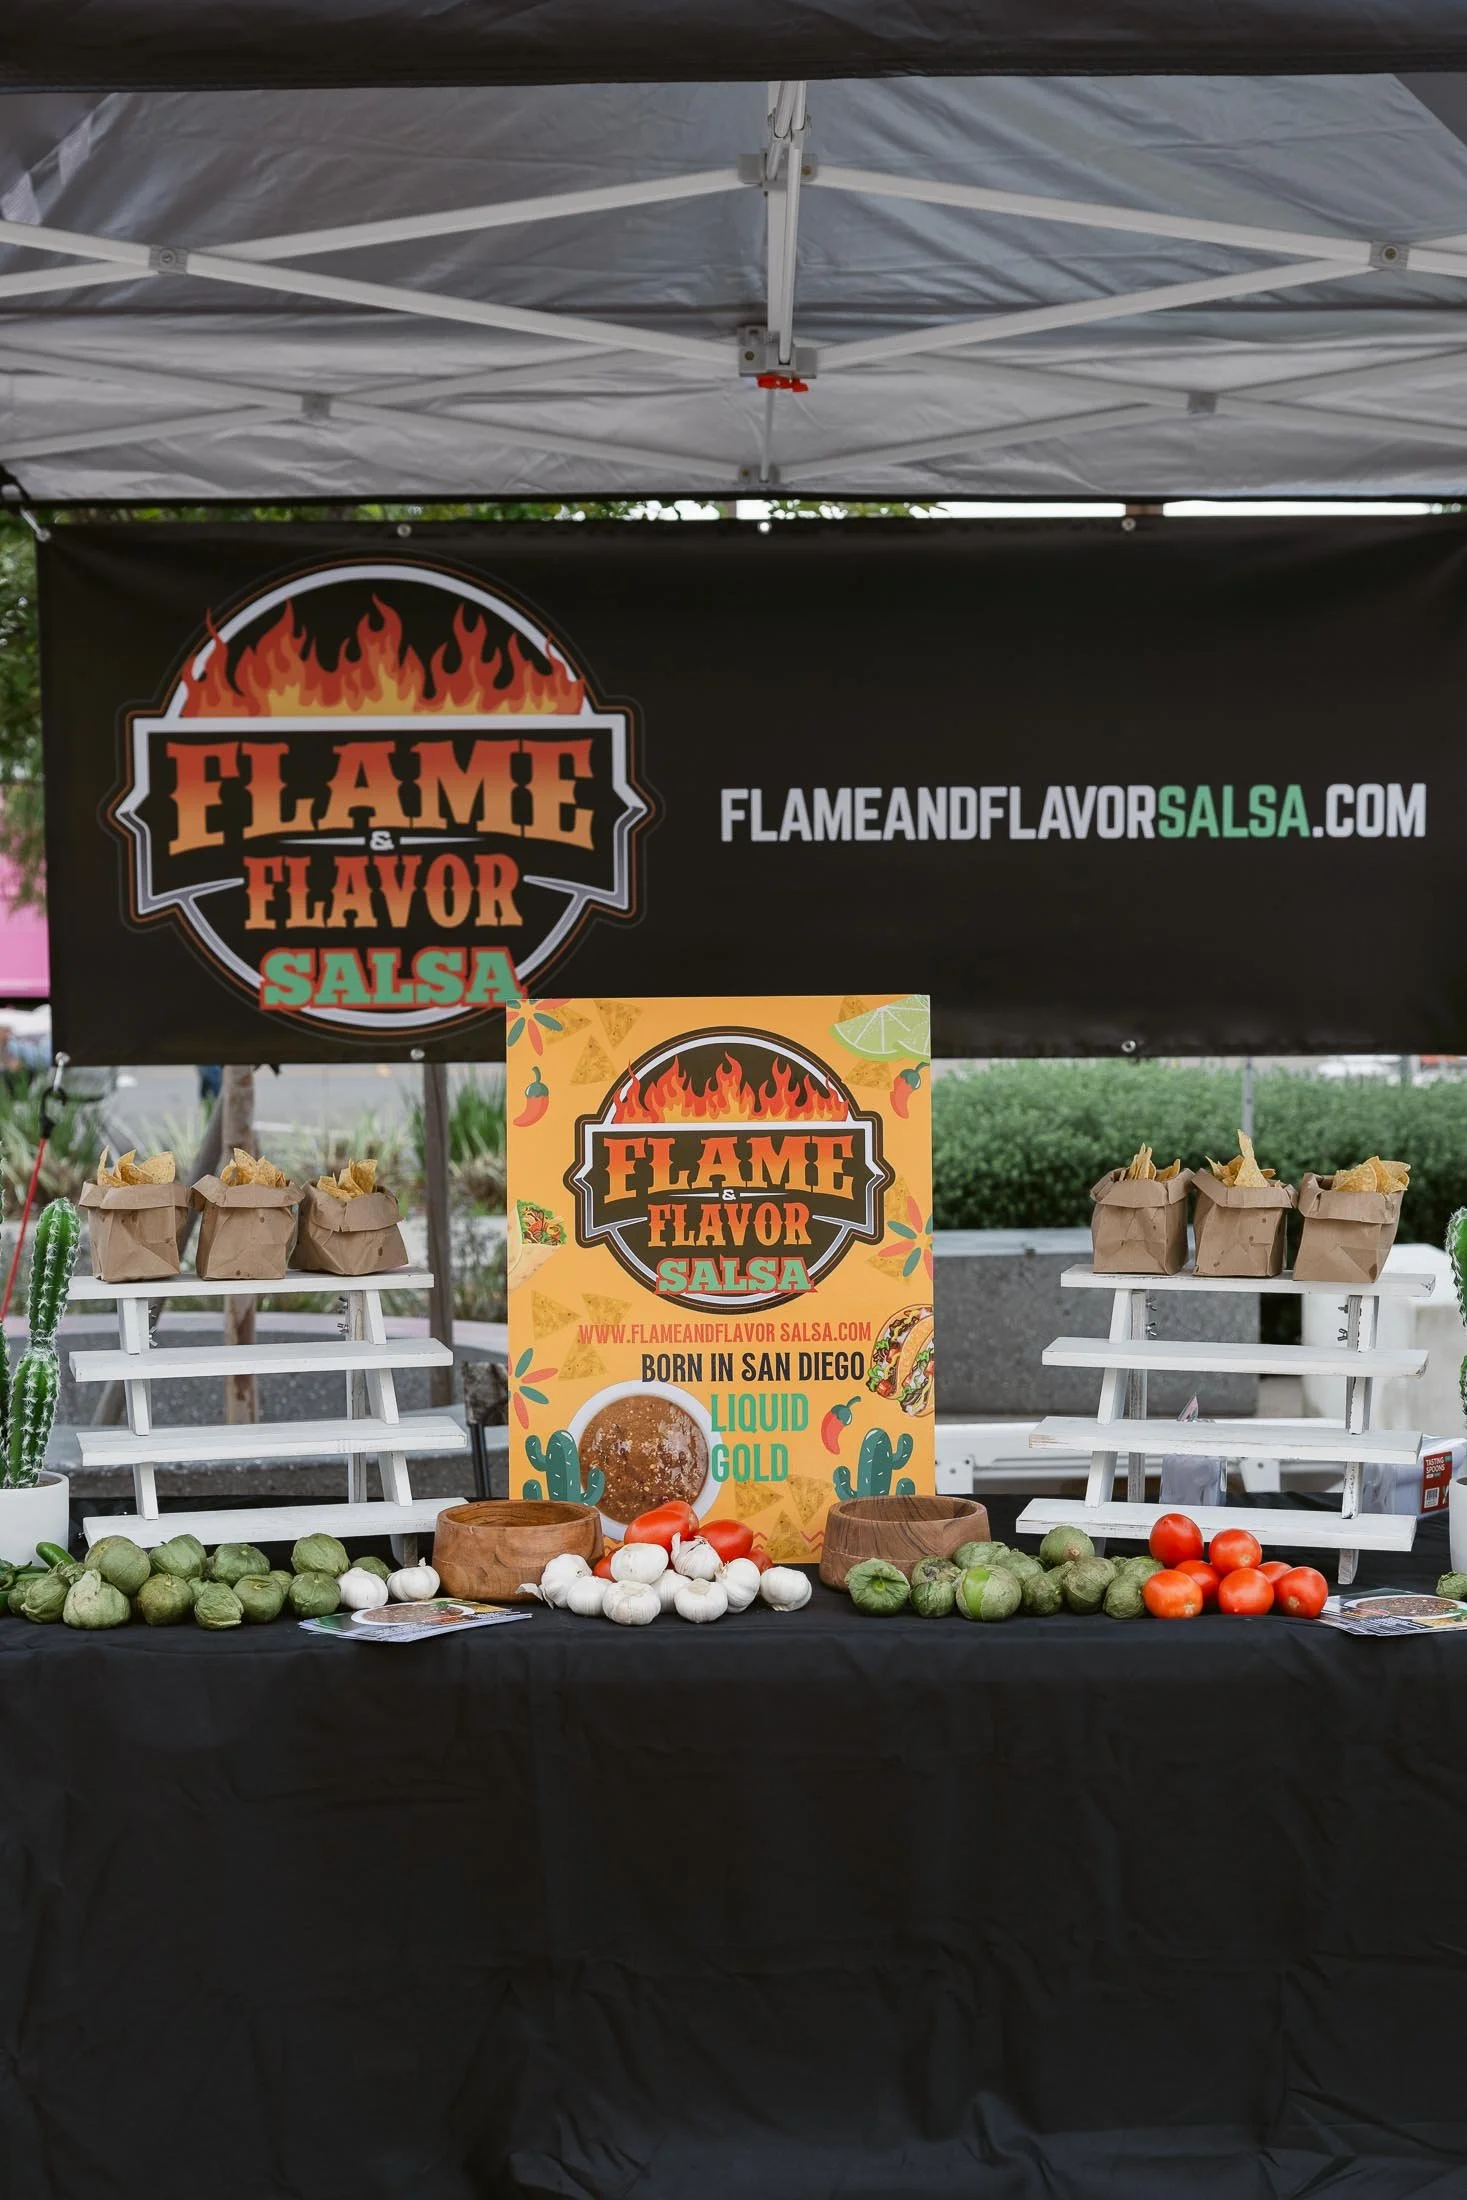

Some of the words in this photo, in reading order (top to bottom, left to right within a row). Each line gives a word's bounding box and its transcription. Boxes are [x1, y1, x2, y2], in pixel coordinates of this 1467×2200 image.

[166, 738, 595, 856] FLAME
[720, 783, 1427, 842] FLAMEANDFLAVORSALSA.COM
[368, 830, 395, 852] &
[243, 853, 524, 930] FLAVOR
[259, 946, 528, 1011] SALSA
[602, 1134, 856, 1205] FLAME
[721, 1188, 737, 1201] &
[647, 1202, 813, 1248] FLAVOR
[655, 1254, 818, 1295] SALSA
[780, 1321, 872, 1342] SALSA.COM
[641, 1352, 703, 1382] BORN
[710, 1352, 734, 1382] IN
[741, 1352, 791, 1382] SAN
[798, 1351, 866, 1381] DIEGO
[710, 1393, 809, 1433] LIQUID
[711, 1443, 789, 1483] GOLD
[1426, 1456, 1445, 1466] TASTING
[1426, 1464, 1446, 1474] SPOONS
